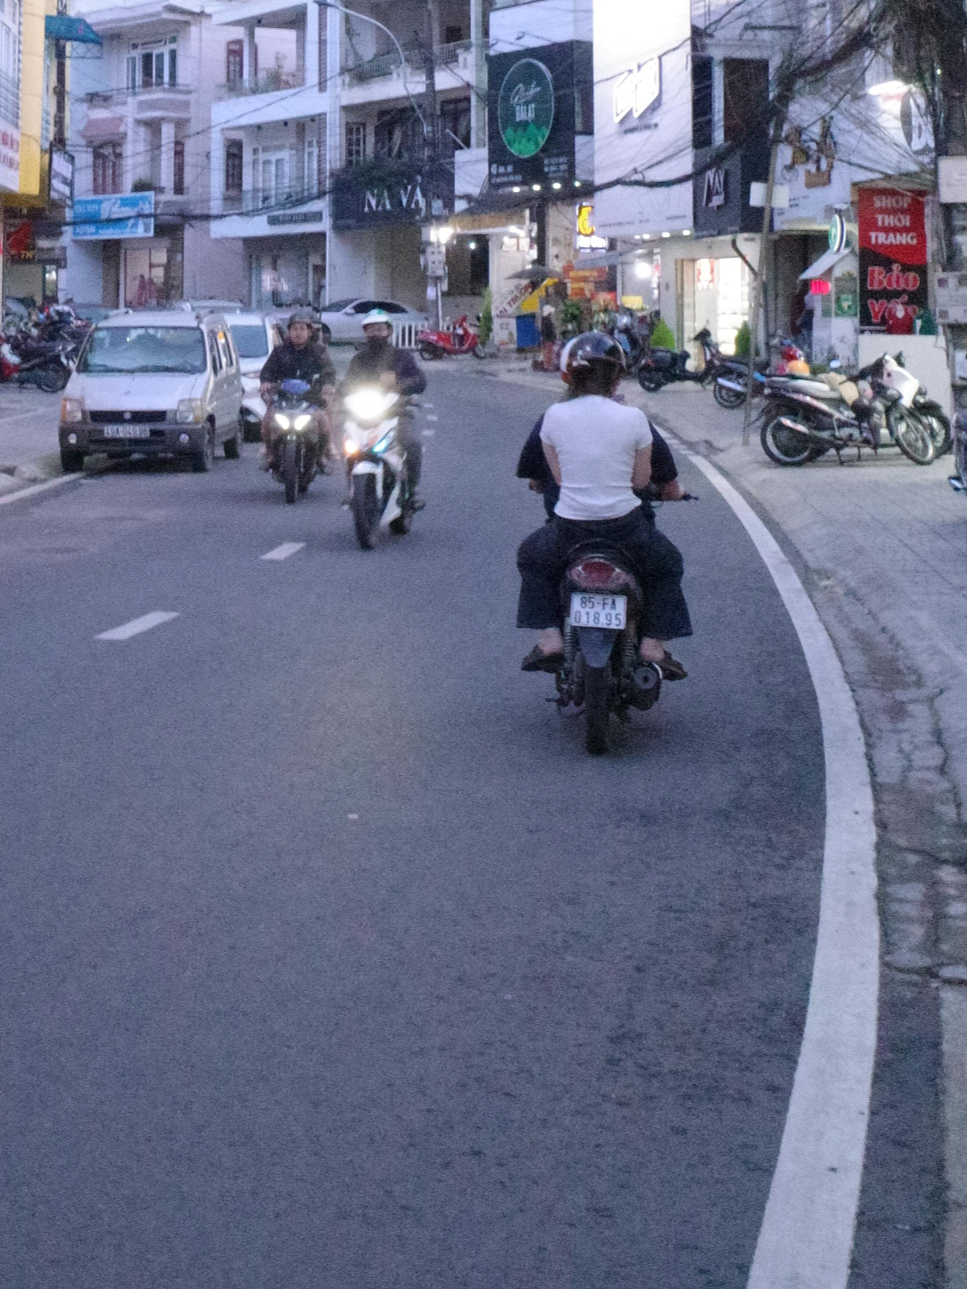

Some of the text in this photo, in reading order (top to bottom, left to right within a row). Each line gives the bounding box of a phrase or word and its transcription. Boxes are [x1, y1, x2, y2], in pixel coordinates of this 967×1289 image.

[873, 196, 912, 209] SHOP
[869, 231, 917, 245] TRANG
[574, 612, 622, 627] 018.95
